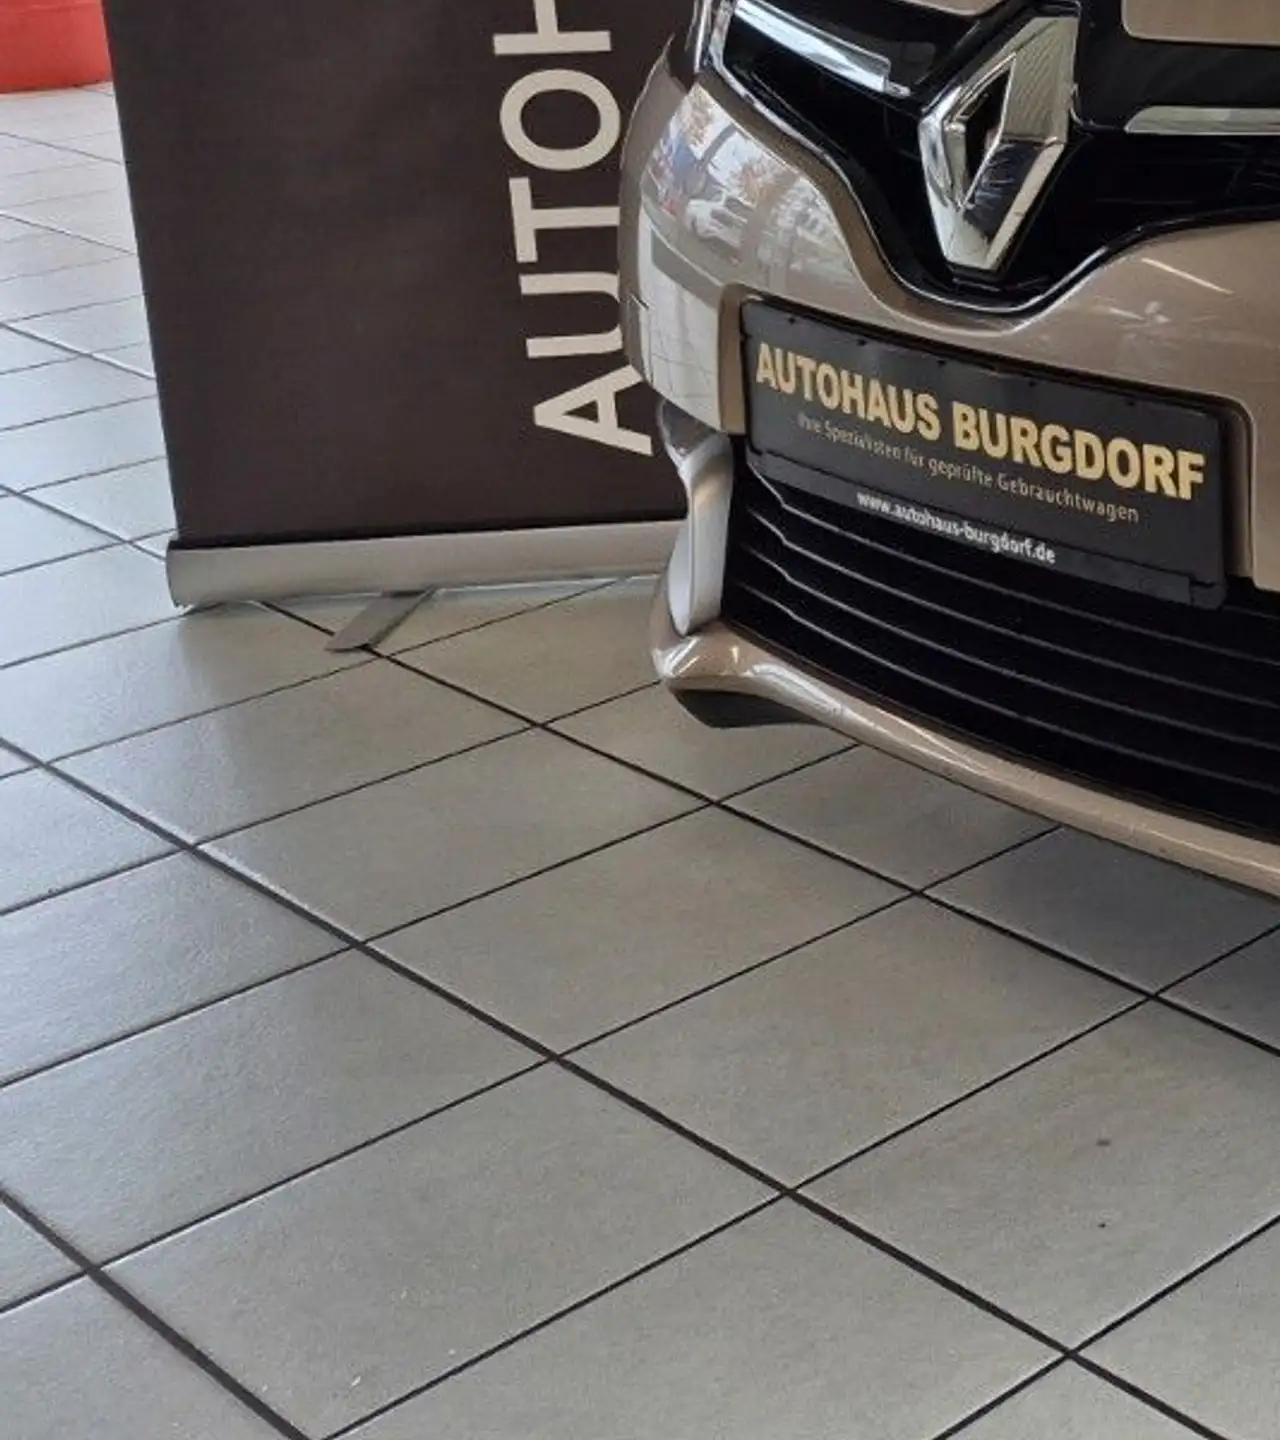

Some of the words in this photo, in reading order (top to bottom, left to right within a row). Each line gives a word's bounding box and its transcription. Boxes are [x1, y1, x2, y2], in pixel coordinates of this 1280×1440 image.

[756, 343, 942, 442] AUTOHAUS
[952, 400, 1206, 501] BURGDORF
[823, 419, 900, 460] Spezialisten
[904, 446, 924, 468] für
[927, 457, 993, 489] geprüfte
[998, 471, 1140, 523] Gebrauchtwagen
[856, 491, 1057, 565] www.autohaus-burgdorf.de
